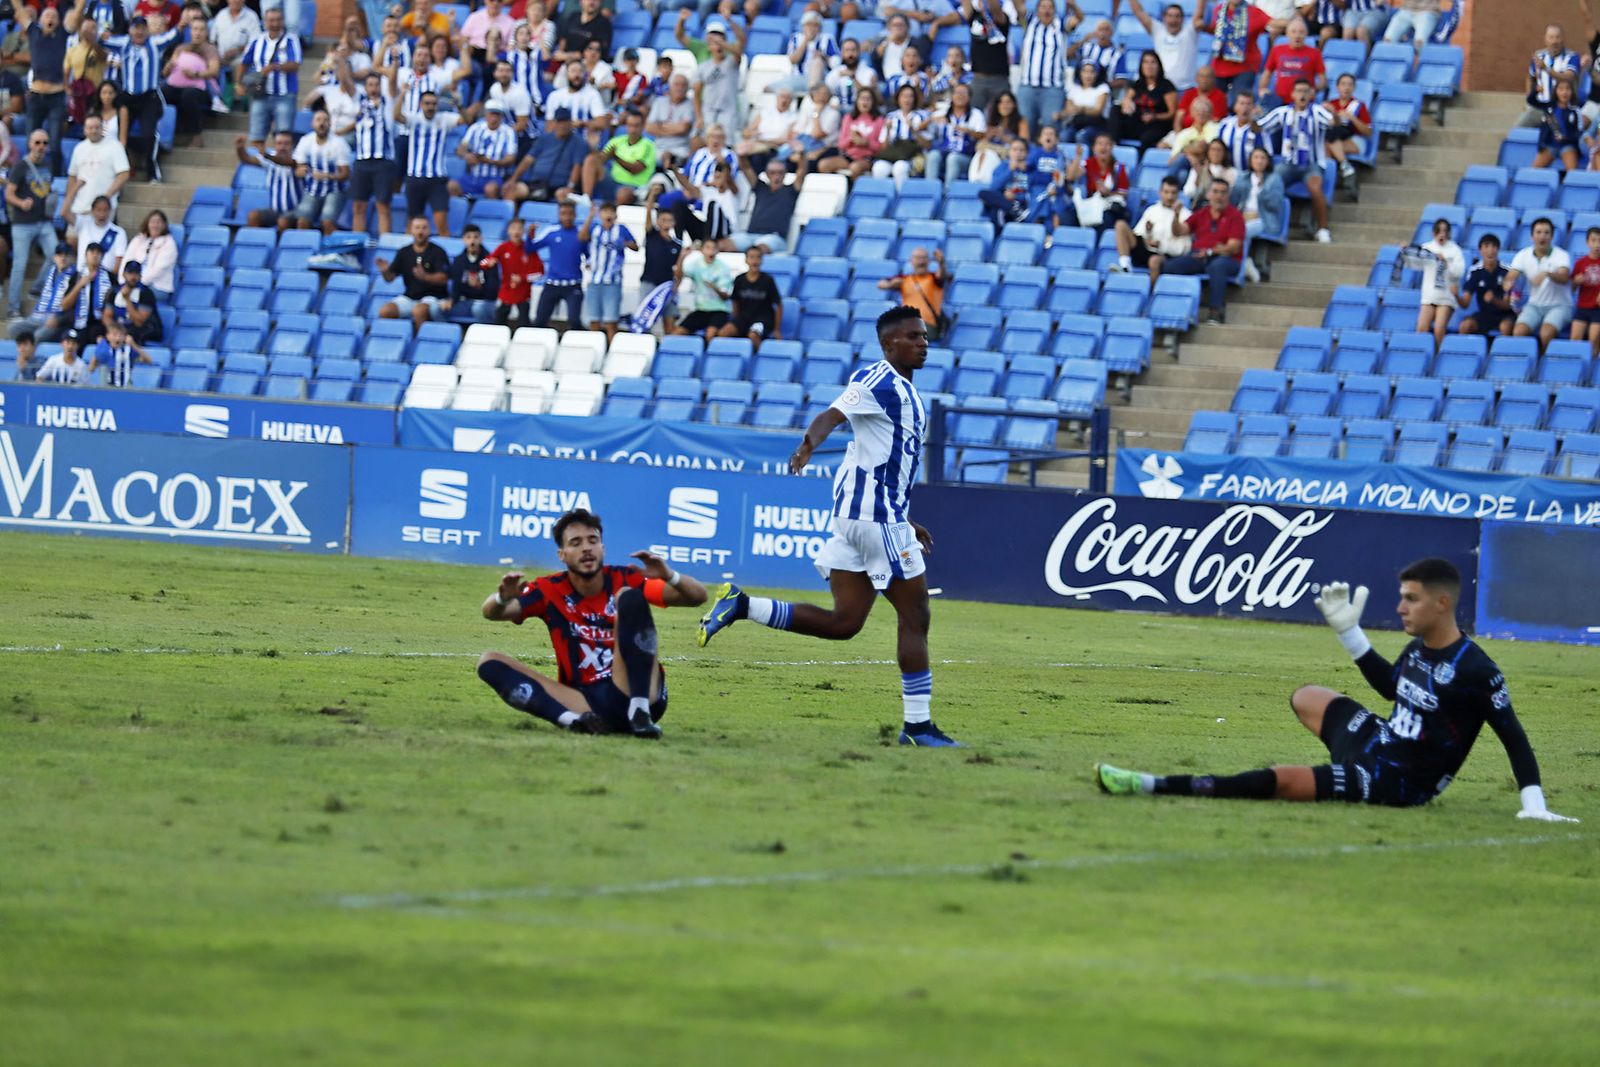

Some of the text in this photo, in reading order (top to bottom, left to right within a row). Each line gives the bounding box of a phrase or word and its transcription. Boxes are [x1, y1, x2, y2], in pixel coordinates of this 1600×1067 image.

[36, 404, 117, 431] HUELVA
[262, 420, 344, 444] HUELVA
[0, 430, 311, 536] MACOEX
[502, 486, 593, 514] HUELVA
[1199, 473, 1348, 506] FARMACIA
[1359, 482, 1471, 514] MOLINO
[1474, 492, 1518, 520] DE
[1524, 498, 1564, 523] LA
[402, 525, 481, 546] SEAT
[500, 513, 562, 539] MOT
[649, 544, 732, 565] SEAT
[1044, 497, 1335, 609] Coca-Cola
